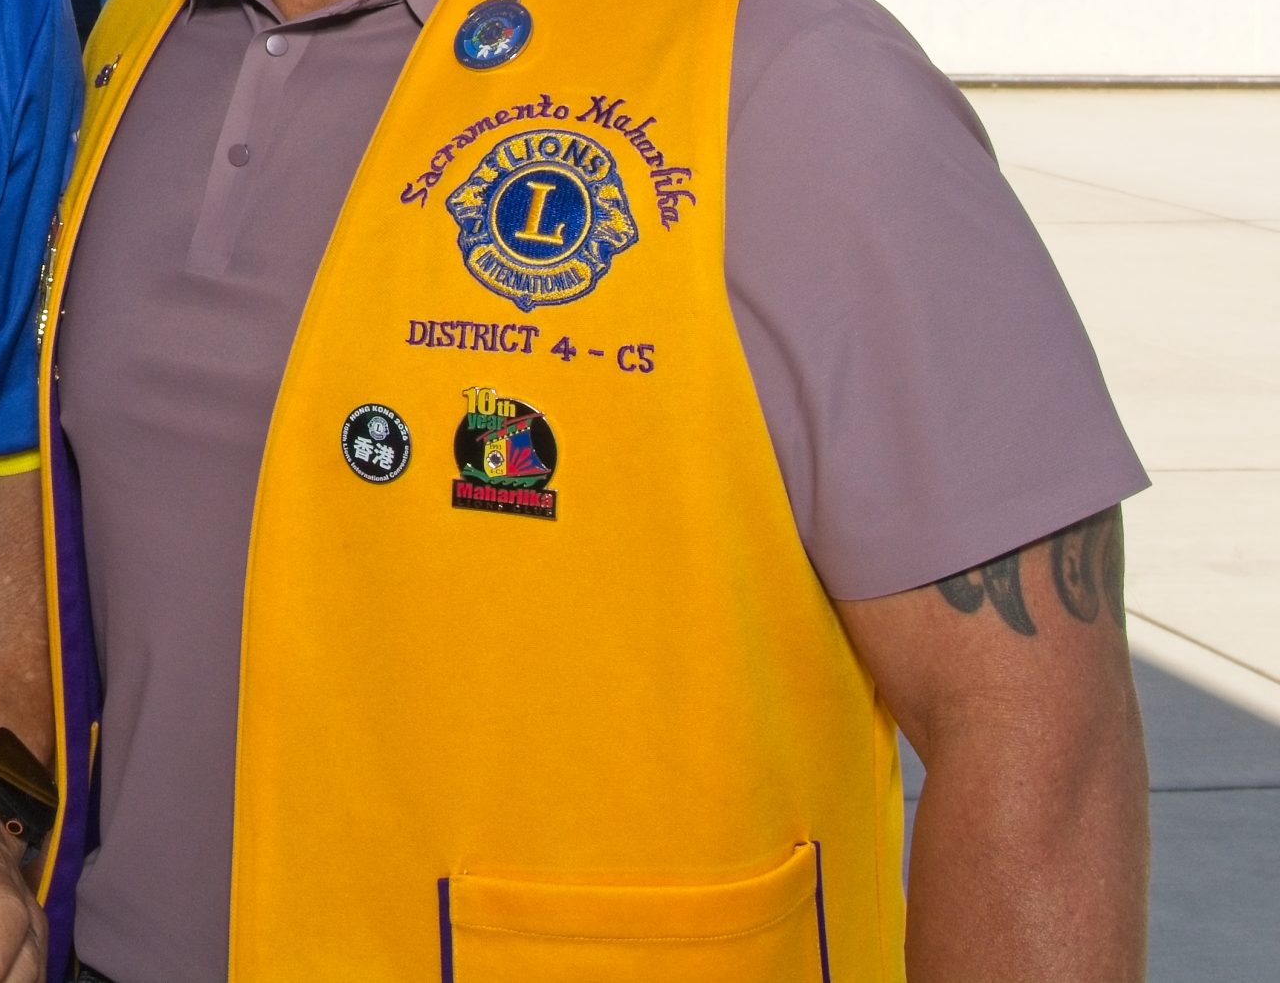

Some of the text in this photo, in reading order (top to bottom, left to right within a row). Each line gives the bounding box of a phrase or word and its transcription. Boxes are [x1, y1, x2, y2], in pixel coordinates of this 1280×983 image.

[400, 94, 697, 232] Sacramento Maharlika
[504, 135, 606, 176] LIONS
[515, 181, 566, 245] L
[477, 249, 585, 294] INTERNATIONAL
[405, 320, 540, 353] DISTRICT
[617, 344, 655, 373] C5
[349, 405, 371, 422] HONG
[372, 404, 395, 419] KONG
[462, 387, 516, 417] 10th
[342, 443, 352, 463] Lions
[350, 462, 390, 482] International
[389, 445, 409, 478] Convention
[353, 435, 395, 470] 香港
[456, 482, 553, 508] Maharlika
